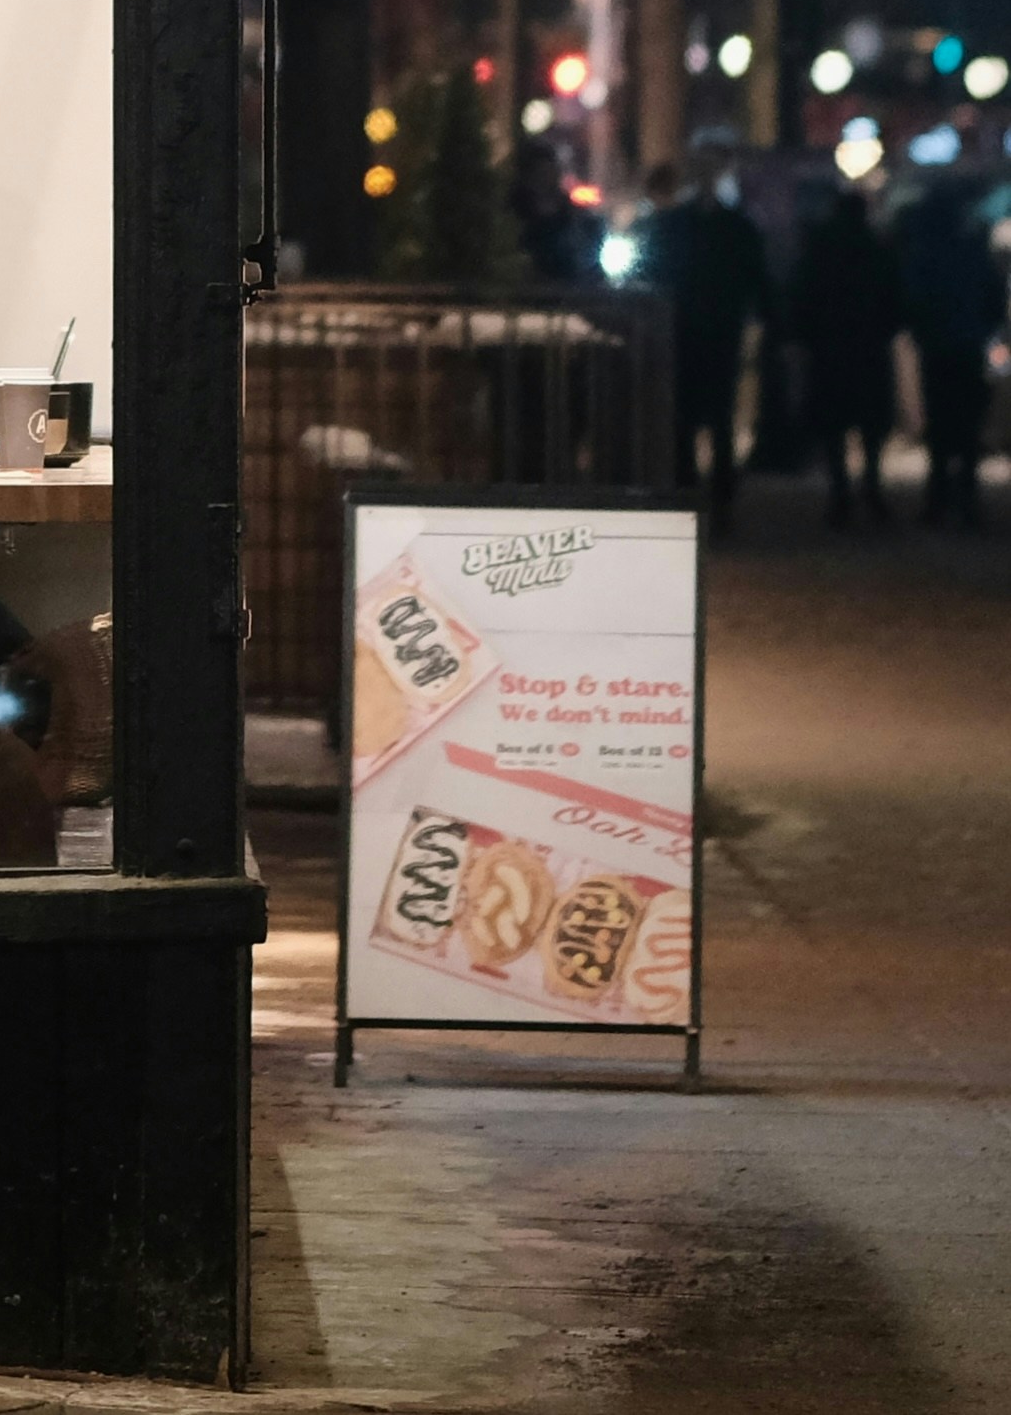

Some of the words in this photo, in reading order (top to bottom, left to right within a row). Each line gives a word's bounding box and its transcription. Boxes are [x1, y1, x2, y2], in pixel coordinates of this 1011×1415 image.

[461, 524, 596, 575] BEAVER
[500, 673, 567, 699] Stop
[576, 674, 598, 696] &
[607, 677, 690, 697] stare.
[499, 704, 539, 721] We
[545, 705, 611, 723] don't
[619, 706, 689, 724] mind.
